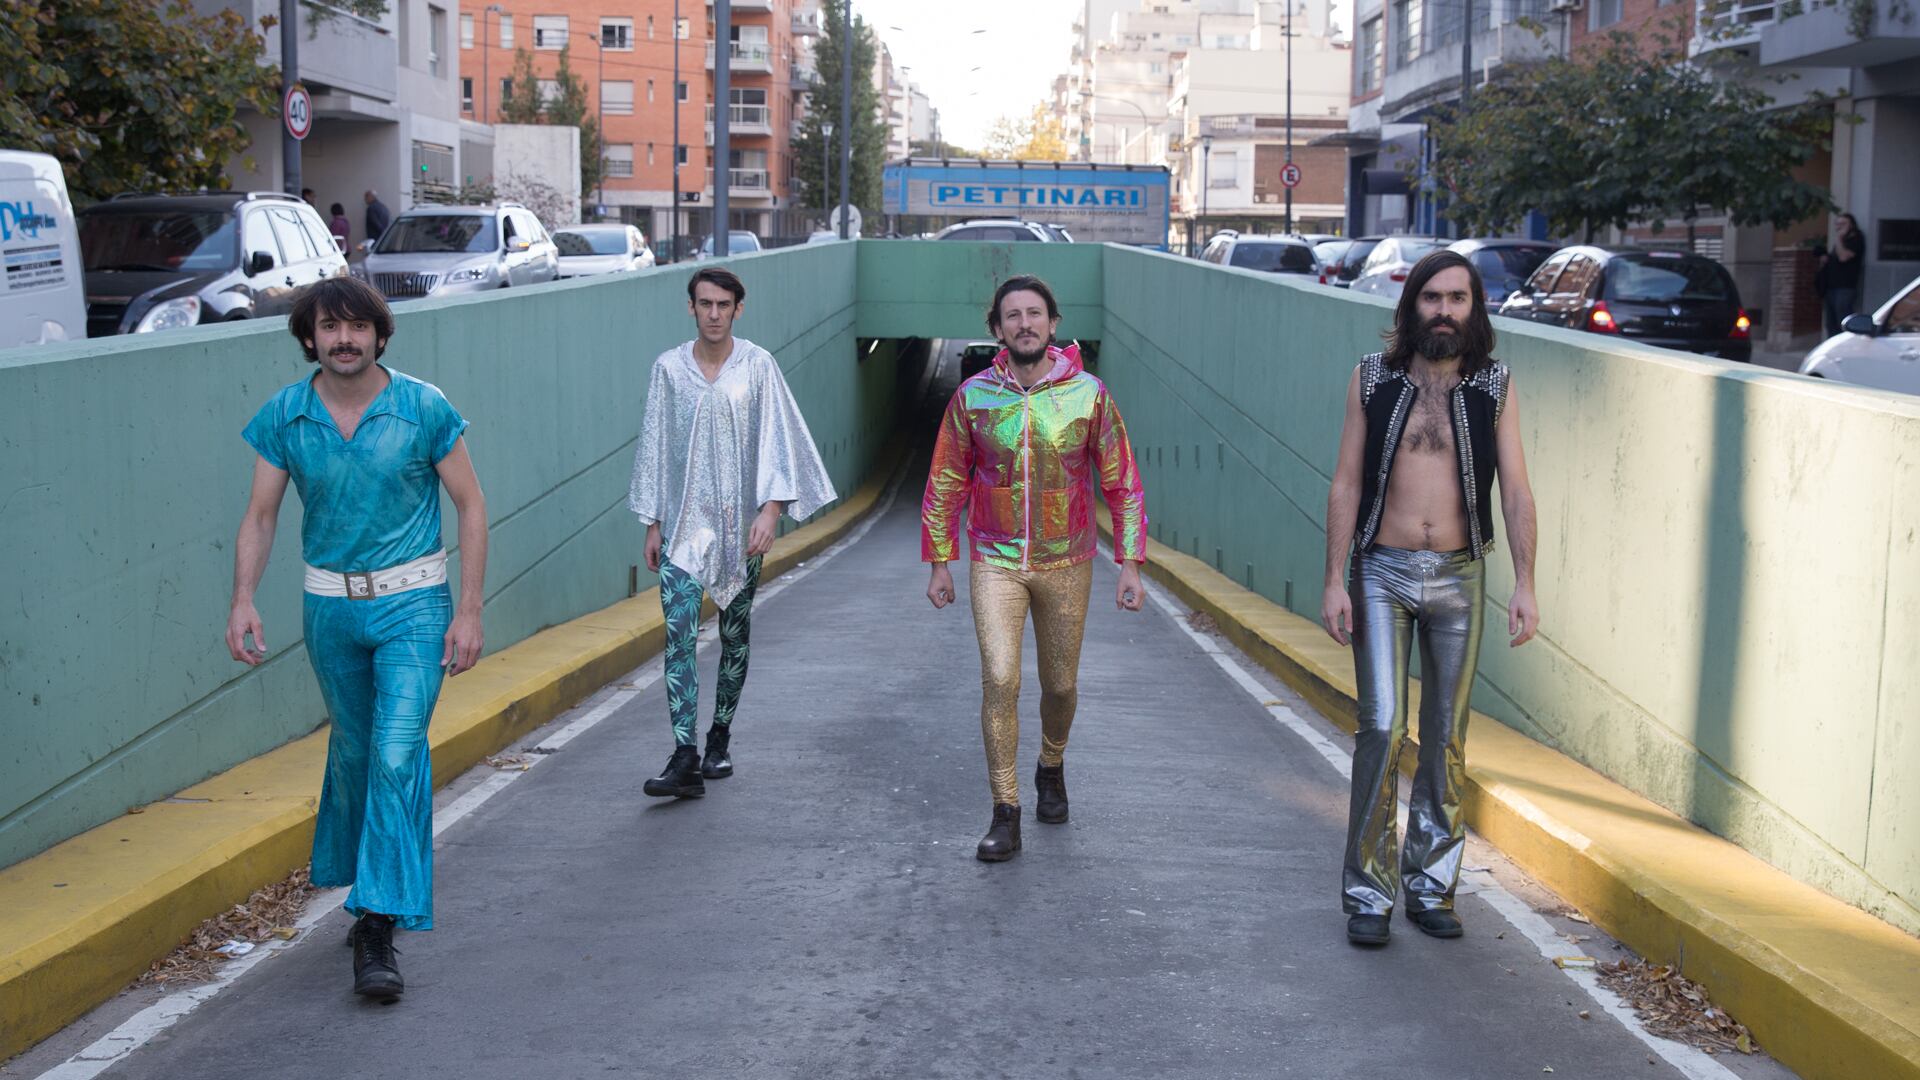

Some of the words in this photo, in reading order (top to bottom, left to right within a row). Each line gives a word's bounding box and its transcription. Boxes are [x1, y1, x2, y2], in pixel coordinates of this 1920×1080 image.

[291, 100, 306, 123] 40
[1287, 169, 1295, 181] E
[937, 186, 1139, 206] PETTINARI
